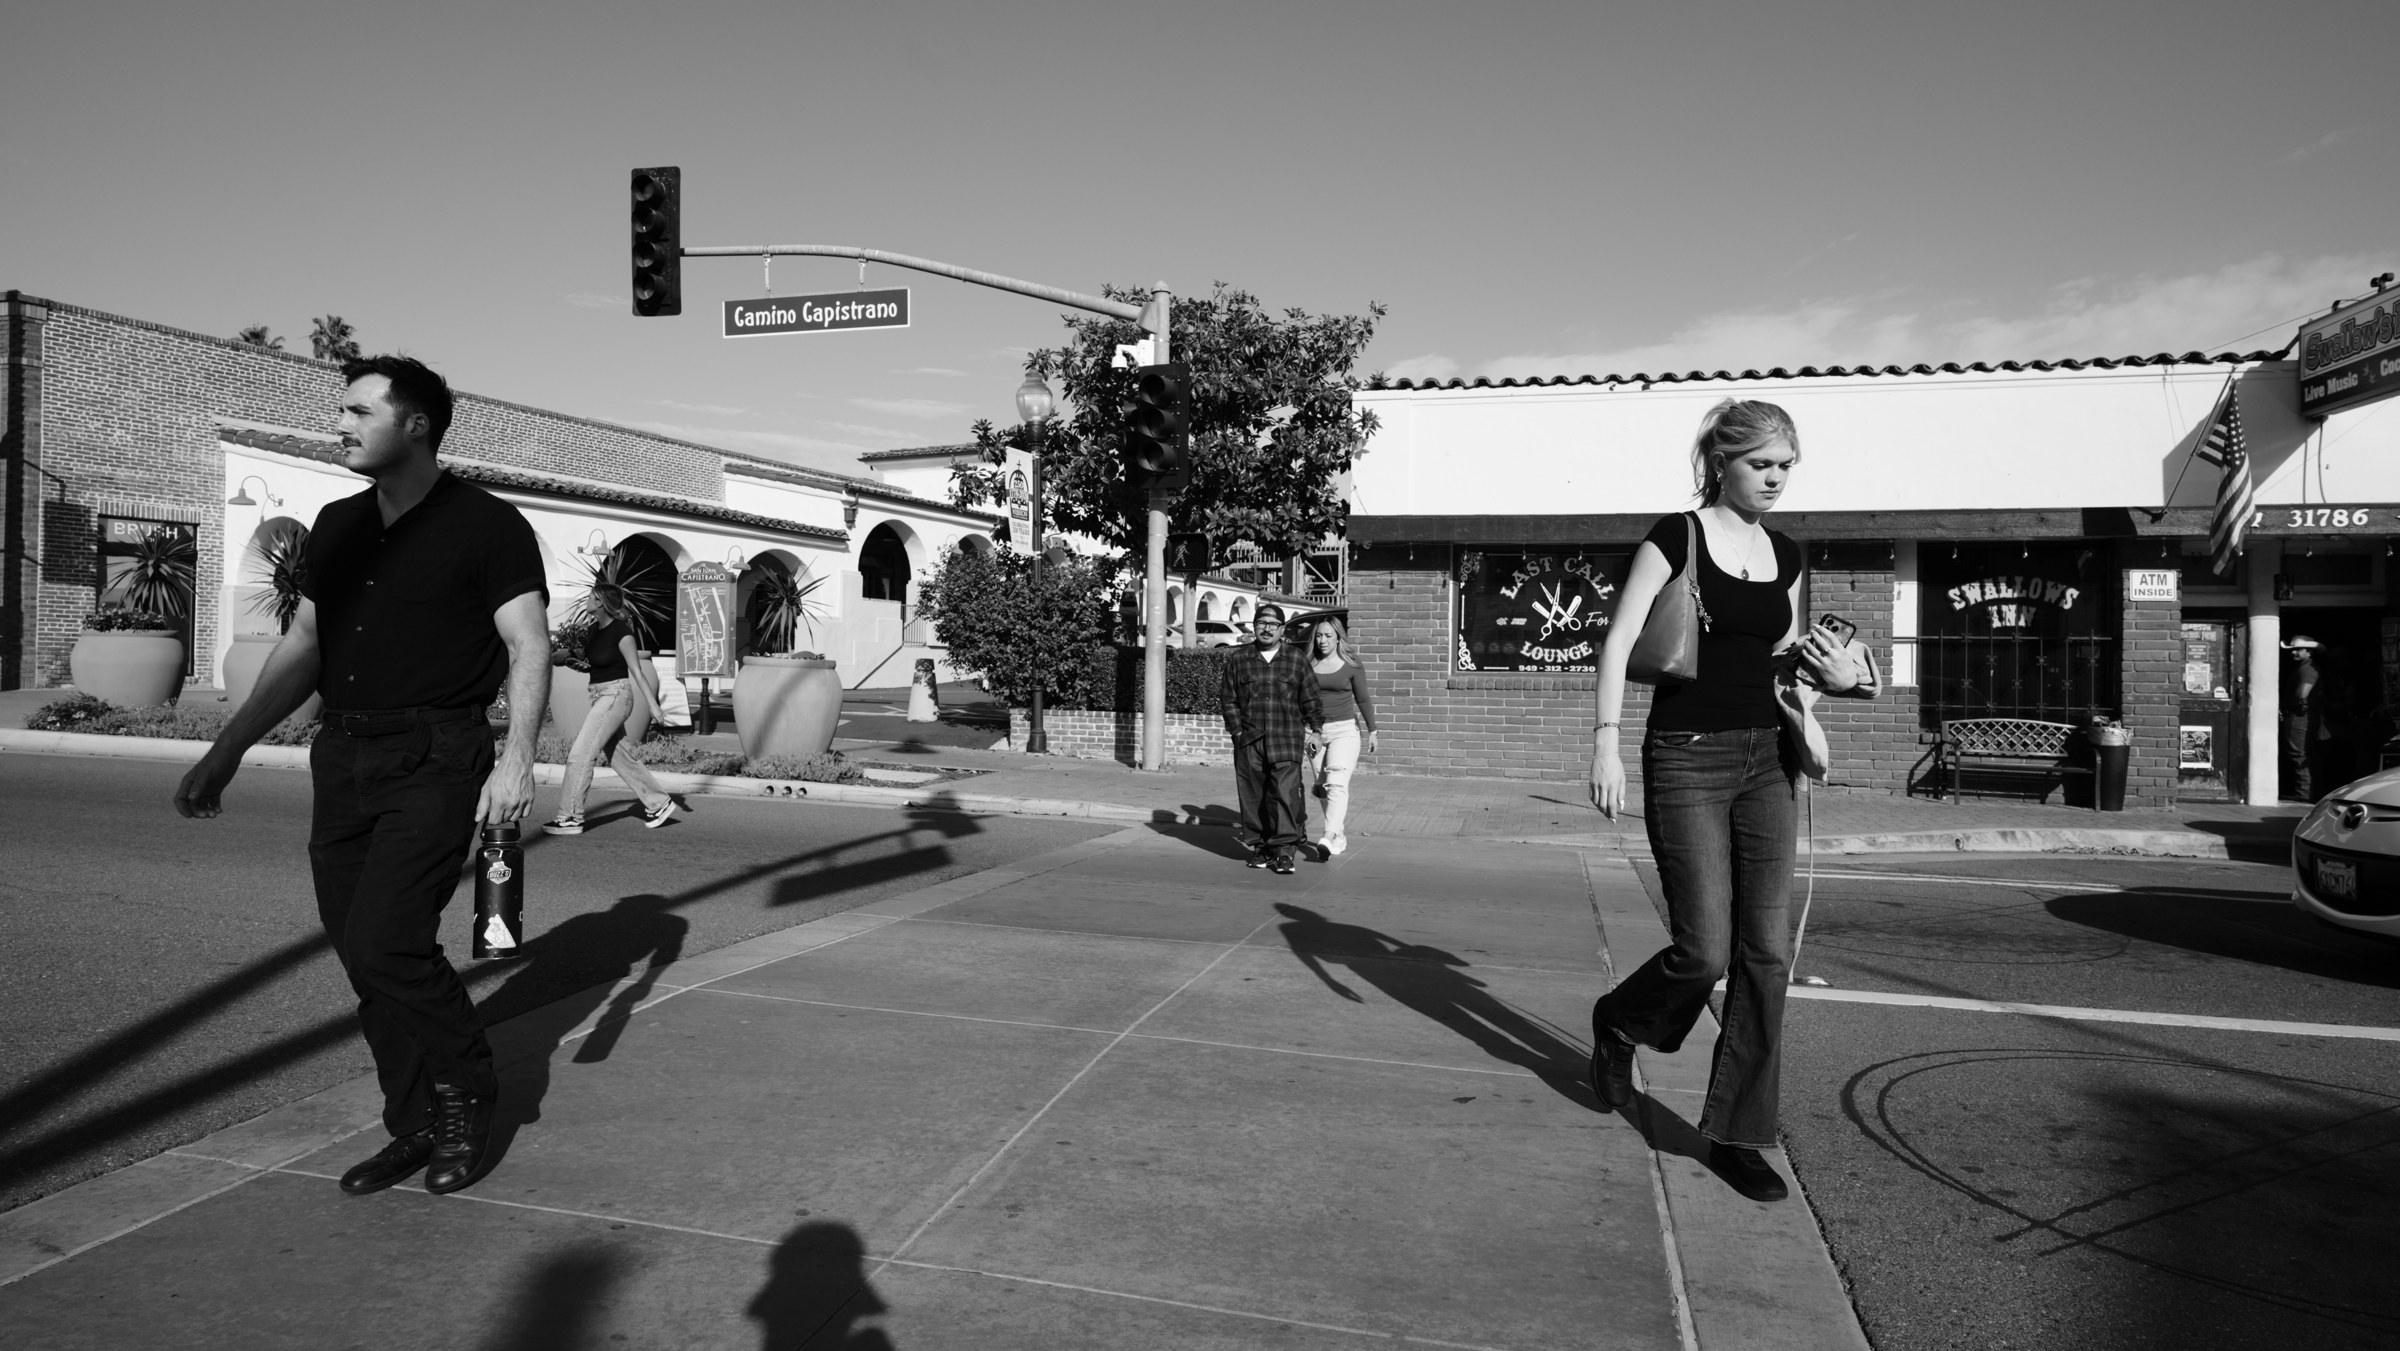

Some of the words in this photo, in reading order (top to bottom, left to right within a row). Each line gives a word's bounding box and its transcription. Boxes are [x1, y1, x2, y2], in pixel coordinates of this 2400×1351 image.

[734, 305, 797, 327] Camino
[802, 300, 898, 328] Capistrano
[2305, 305, 2393, 371] Swallow's
[2303, 384, 2326, 403] Live
[2327, 371, 2359, 395] Music
[2287, 508, 2370, 528] 31786
[113, 521, 178, 540] BRUSH
[681, 573, 726, 581] CAPISTRANO
[1500, 556, 1553, 600] LAST
[1563, 557, 1615, 600] CALL
[2139, 573, 2168, 586] ATM
[1947, 576, 2080, 611] SWALLOWS
[2134, 588, 2174, 597] INSIDE
[1988, 603, 2037, 629] INN
[1519, 641, 1594, 664] LOUNGE
